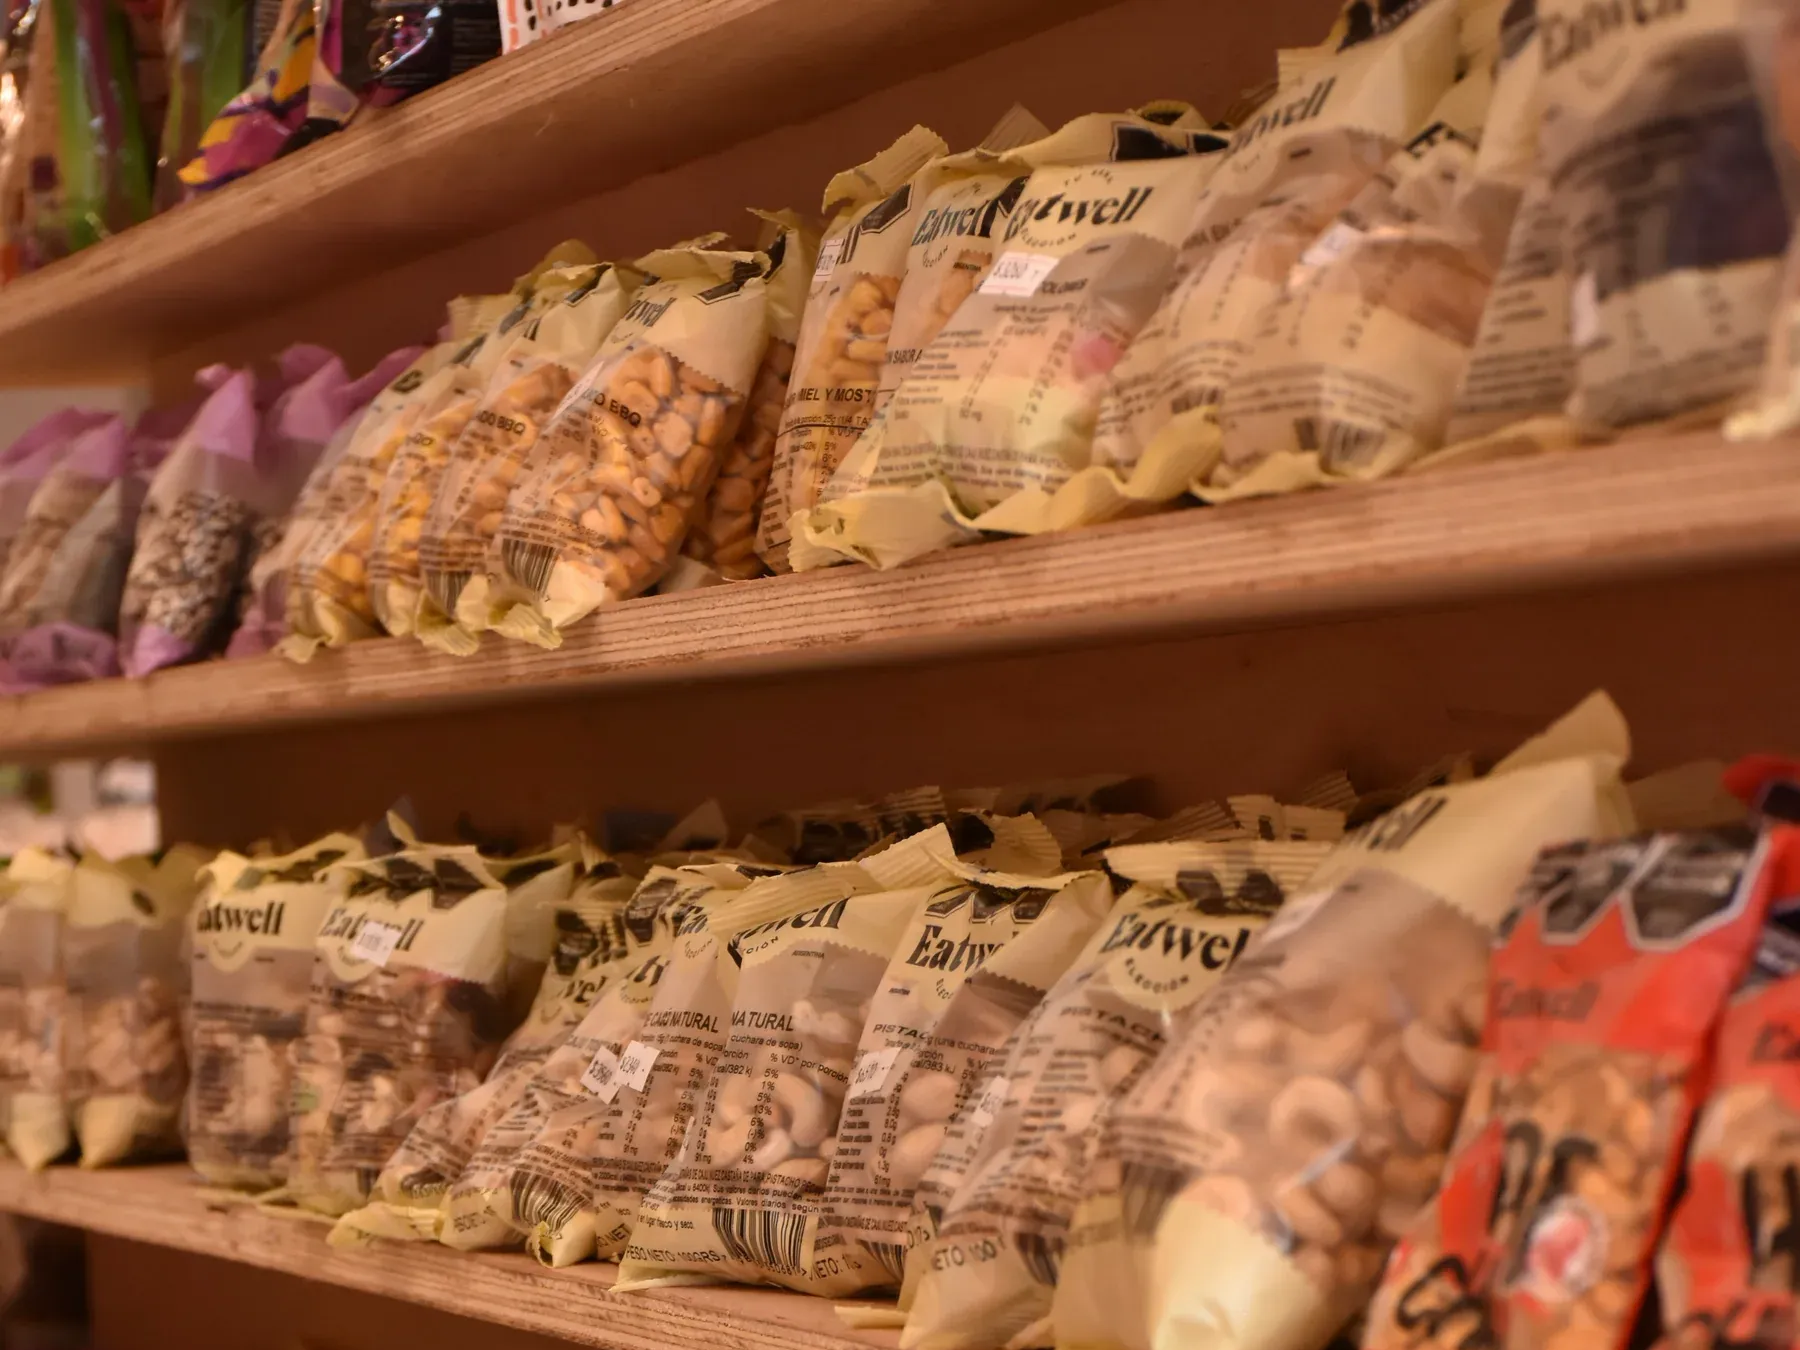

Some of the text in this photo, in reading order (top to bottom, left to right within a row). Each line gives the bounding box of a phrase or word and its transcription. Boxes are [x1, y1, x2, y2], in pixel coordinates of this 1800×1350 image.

[196, 901, 285, 936] atwell
[319, 907, 424, 951] Eatll
[905, 923, 1006, 973] Eatw
[1099, 912, 1250, 971] Eatwel
[668, 1010, 720, 1034] NATURAL
[873, 1023, 930, 1044] PISTAC
[704, 1040, 725, 1052] sopa
[730, 1034, 765, 1047] cuchara
[766, 1036, 777, 1047] de
[956, 1040, 996, 1056] cuchara
[917, 1050, 945, 1060] rción
[764, 1067, 779, 1080] 5%
[769, 1052, 779, 1063] %
[781, 1053, 799, 1066] VD
[800, 1058, 816, 1070] por
[816, 1063, 850, 1085] porción
[761, 1080, 776, 1092] 1%
[756, 1092, 772, 1104] 5%
[752, 1104, 773, 1117] 13%
[750, 1116, 765, 1128] 6%
[744, 1141, 758, 1152] 0%
[742, 1153, 755, 1166] 4%
[791, 1202, 820, 1215] según
[606, 1222, 632, 1245] NET
[931, 1245, 965, 1271] ETO
